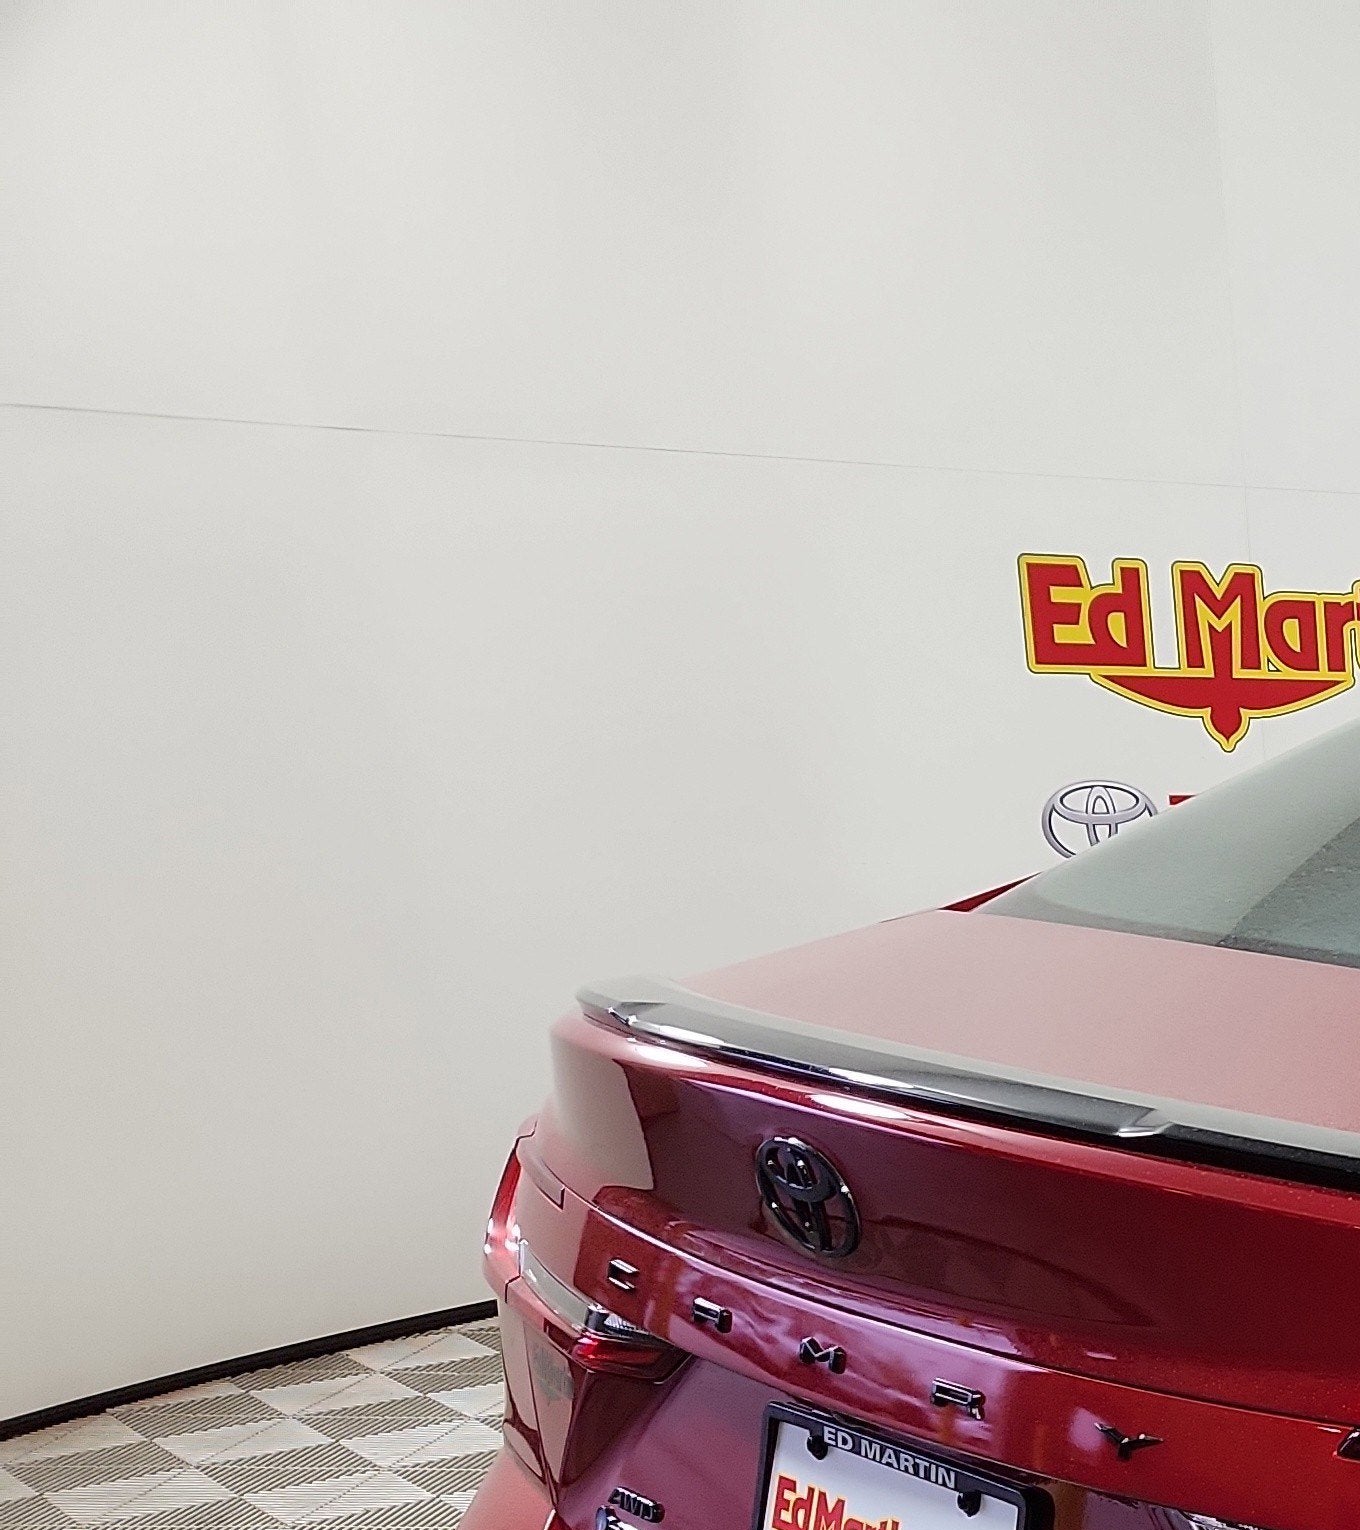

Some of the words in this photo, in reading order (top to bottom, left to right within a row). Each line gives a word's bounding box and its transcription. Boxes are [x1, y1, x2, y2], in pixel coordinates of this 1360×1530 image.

[1019, 555, 1153, 672] Ed
[822, 1426, 854, 1452] ED
[860, 1440, 957, 1489] MARTIN
